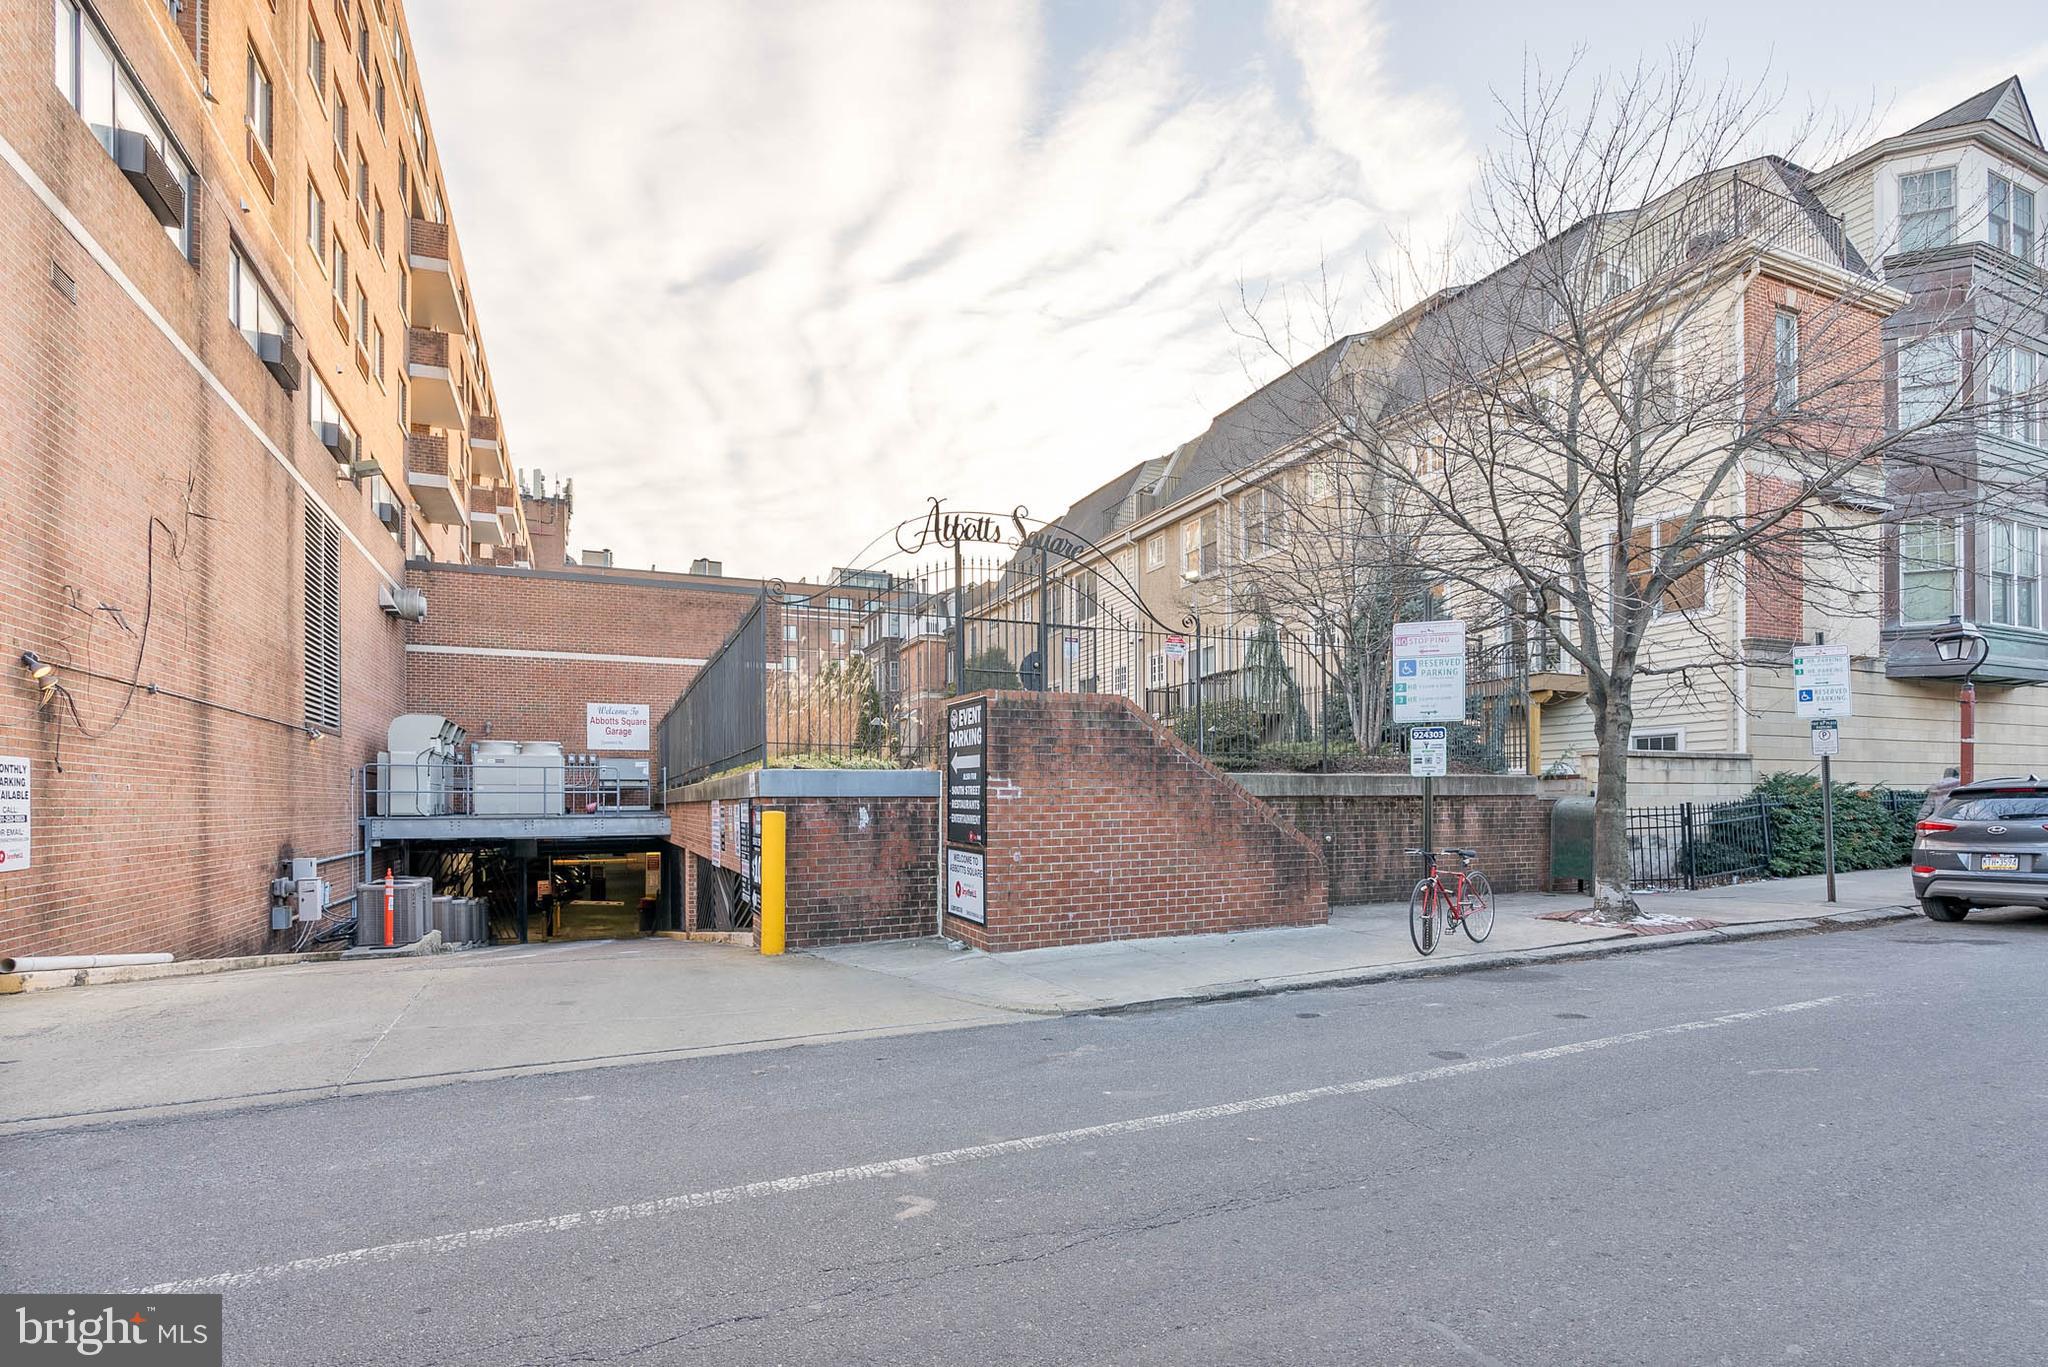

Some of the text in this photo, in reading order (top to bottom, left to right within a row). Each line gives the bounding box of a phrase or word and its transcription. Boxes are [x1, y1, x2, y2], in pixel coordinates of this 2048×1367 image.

[896, 497, 1084, 560] Abbotts Square
[1419, 658, 1461, 667] RESERVED
[1421, 668, 1458, 676] PARKING
[590, 716, 647, 726] Abbotts Square
[958, 705, 982, 727] EVENT
[605, 727, 632, 738] Garage
[949, 727, 982, 748] PARKING
[1413, 731, 1444, 739] 924303
